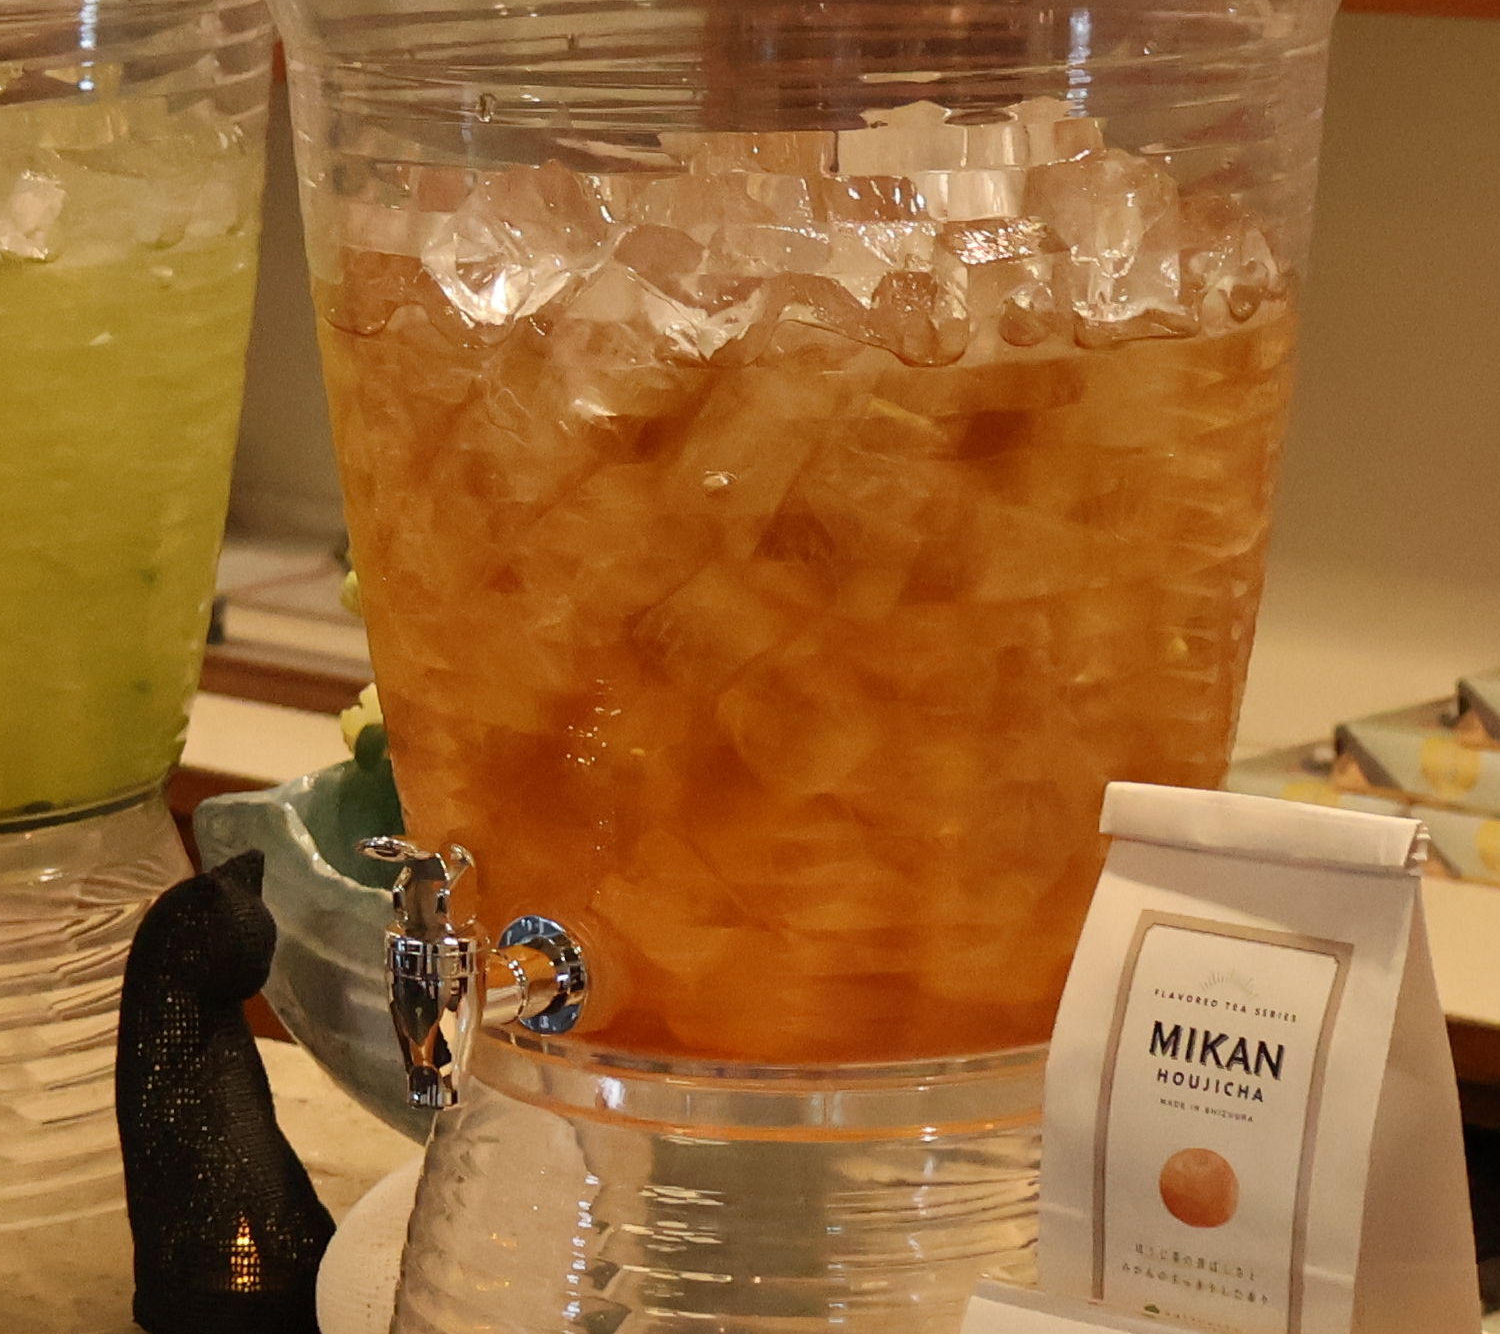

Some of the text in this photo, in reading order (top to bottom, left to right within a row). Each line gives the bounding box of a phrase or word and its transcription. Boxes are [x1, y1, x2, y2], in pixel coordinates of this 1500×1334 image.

[1154, 988, 1297, 1023] FLAVORED TEA SERIES
[1149, 1020, 1286, 1081] MIKAN
[1156, 1067, 1264, 1103] HOUJICHA
[1160, 1098, 1186, 1110] MADE
